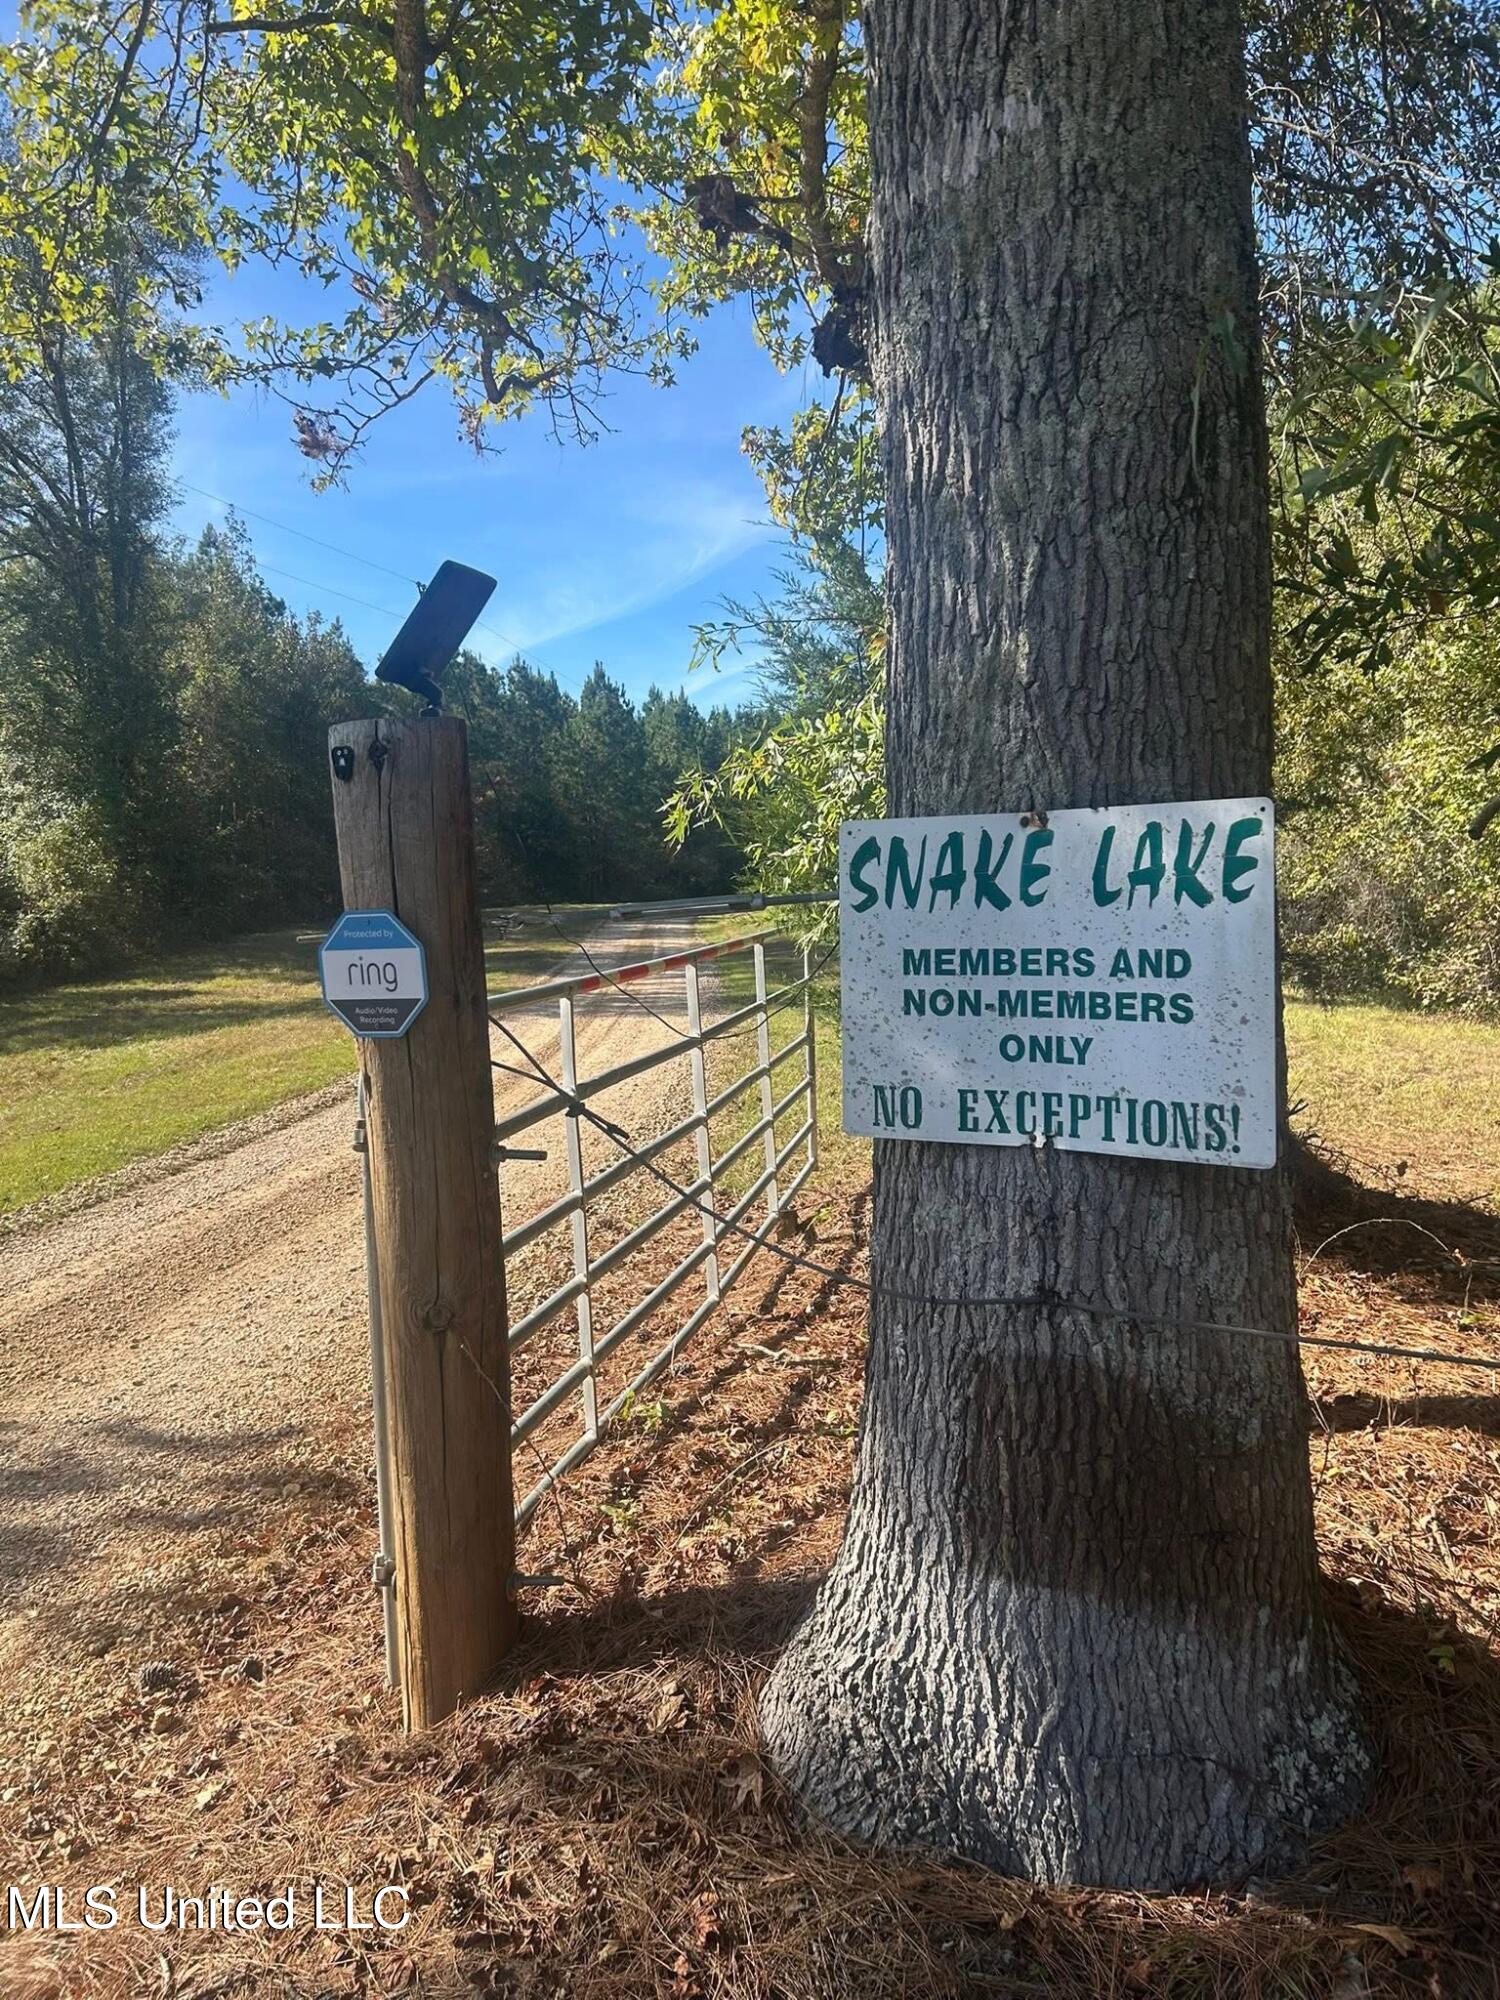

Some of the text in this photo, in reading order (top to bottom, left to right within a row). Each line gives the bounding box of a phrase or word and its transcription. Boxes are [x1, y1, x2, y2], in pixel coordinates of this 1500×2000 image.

[849, 817, 1264, 914] SNAKE LAKE
[344, 929, 393, 938] Protected by
[348, 956, 398, 992] ring
[902, 948, 1192, 979] MEMBERS AND
[355, 1007, 398, 1015] Audio/Video
[360, 1016, 395, 1024] Recording
[902, 989, 1194, 1025] NON-MEMBERS
[1000, 1034, 1094, 1065] ONLY
[872, 1084, 1241, 1154] NO EXCEPTIONS!
